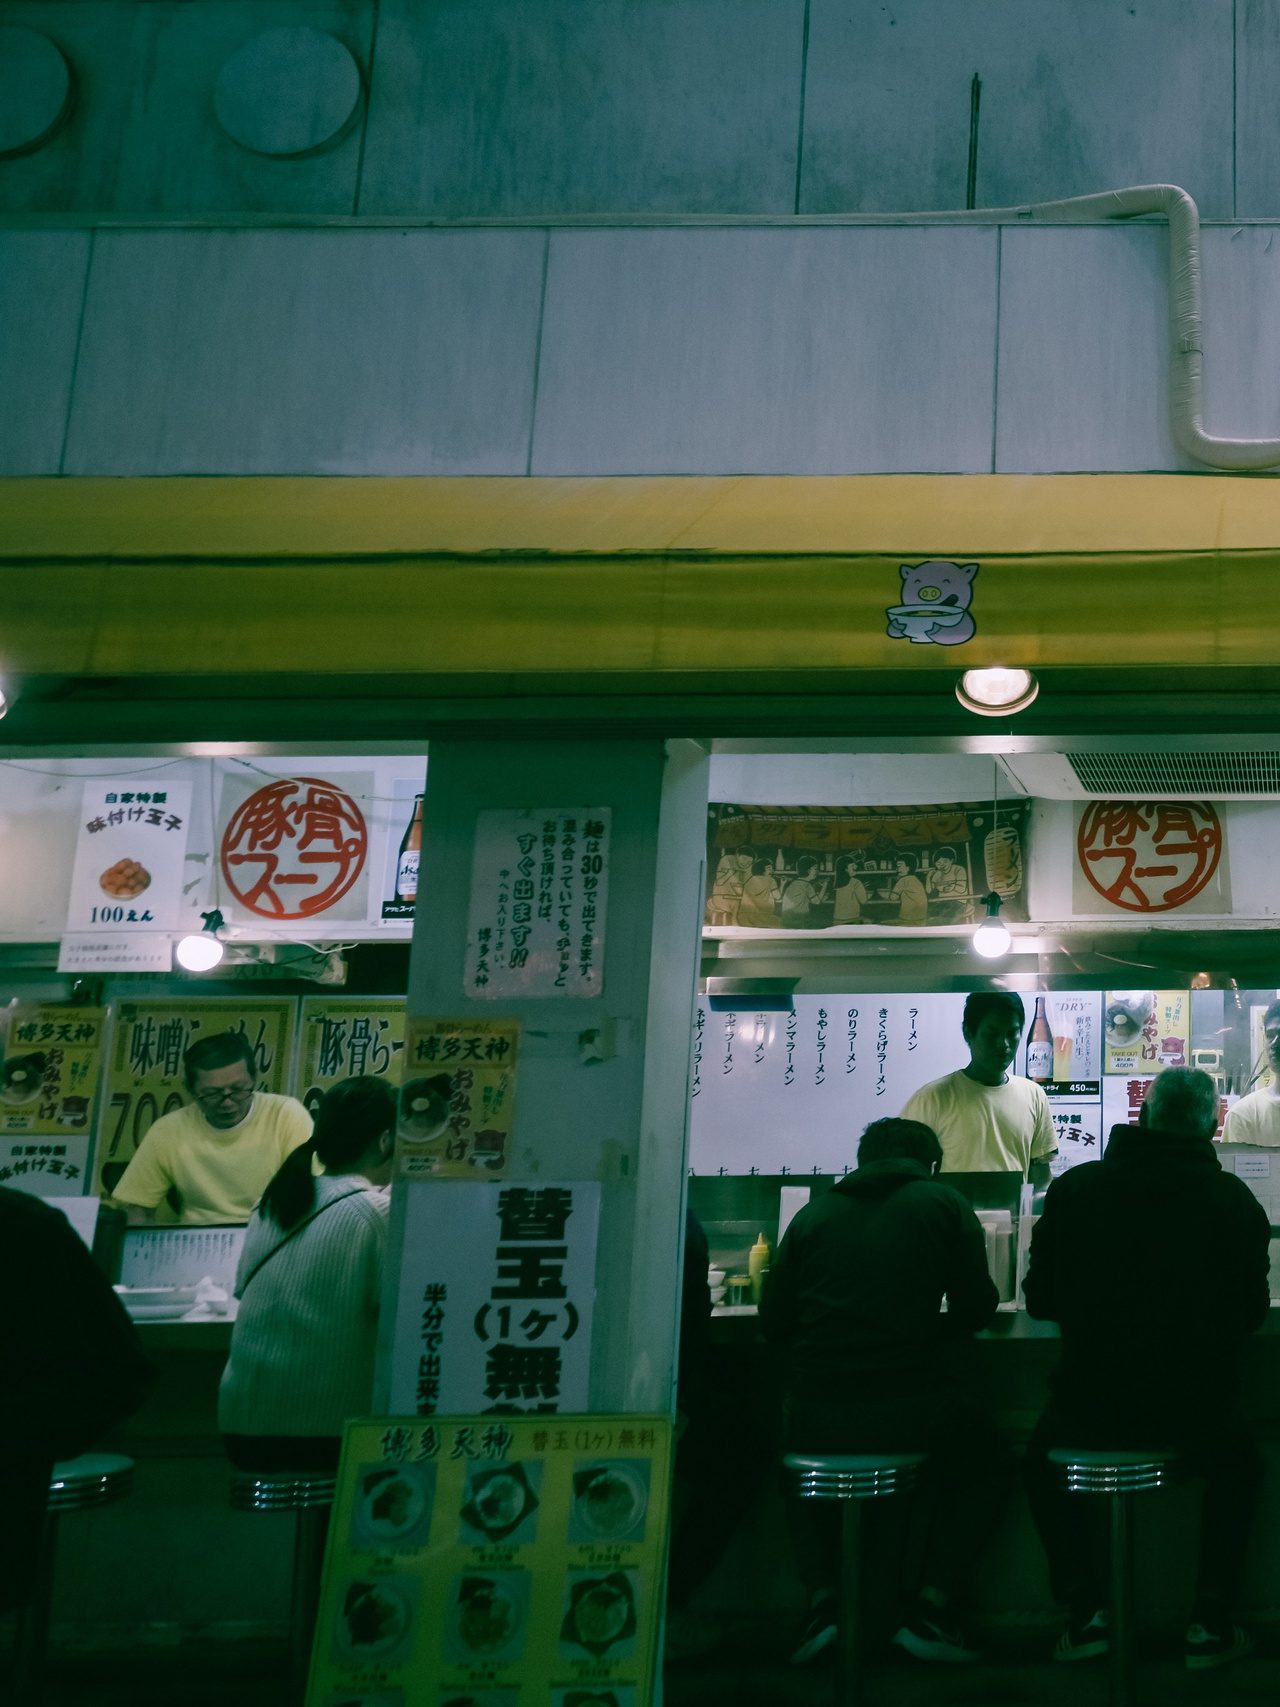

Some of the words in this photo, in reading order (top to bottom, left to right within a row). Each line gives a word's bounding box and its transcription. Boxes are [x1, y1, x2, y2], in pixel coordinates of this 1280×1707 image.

[86, 807, 183, 834] 味付け玉子
[105, 793, 167, 804] 自家特製
[91, 906, 154, 923] 100えん
[580, 819, 604, 982] 麺は30秒で出てきます。
[475, 927, 492, 987] 博多天神
[17, 1023, 96, 1043] 博多天神
[416, 1036, 510, 1061] 博多天神
[785, 1009, 798, 1086] メンマラーメン
[815, 1008, 829, 1086] もやしラーメン
[846, 1008, 860, 1074] のりラーメン
[876, 1008, 890, 1096] きくらげラーメン
[907, 1008, 920, 1052] ラーメン
[381, 1425, 515, 1463] 博多天神
